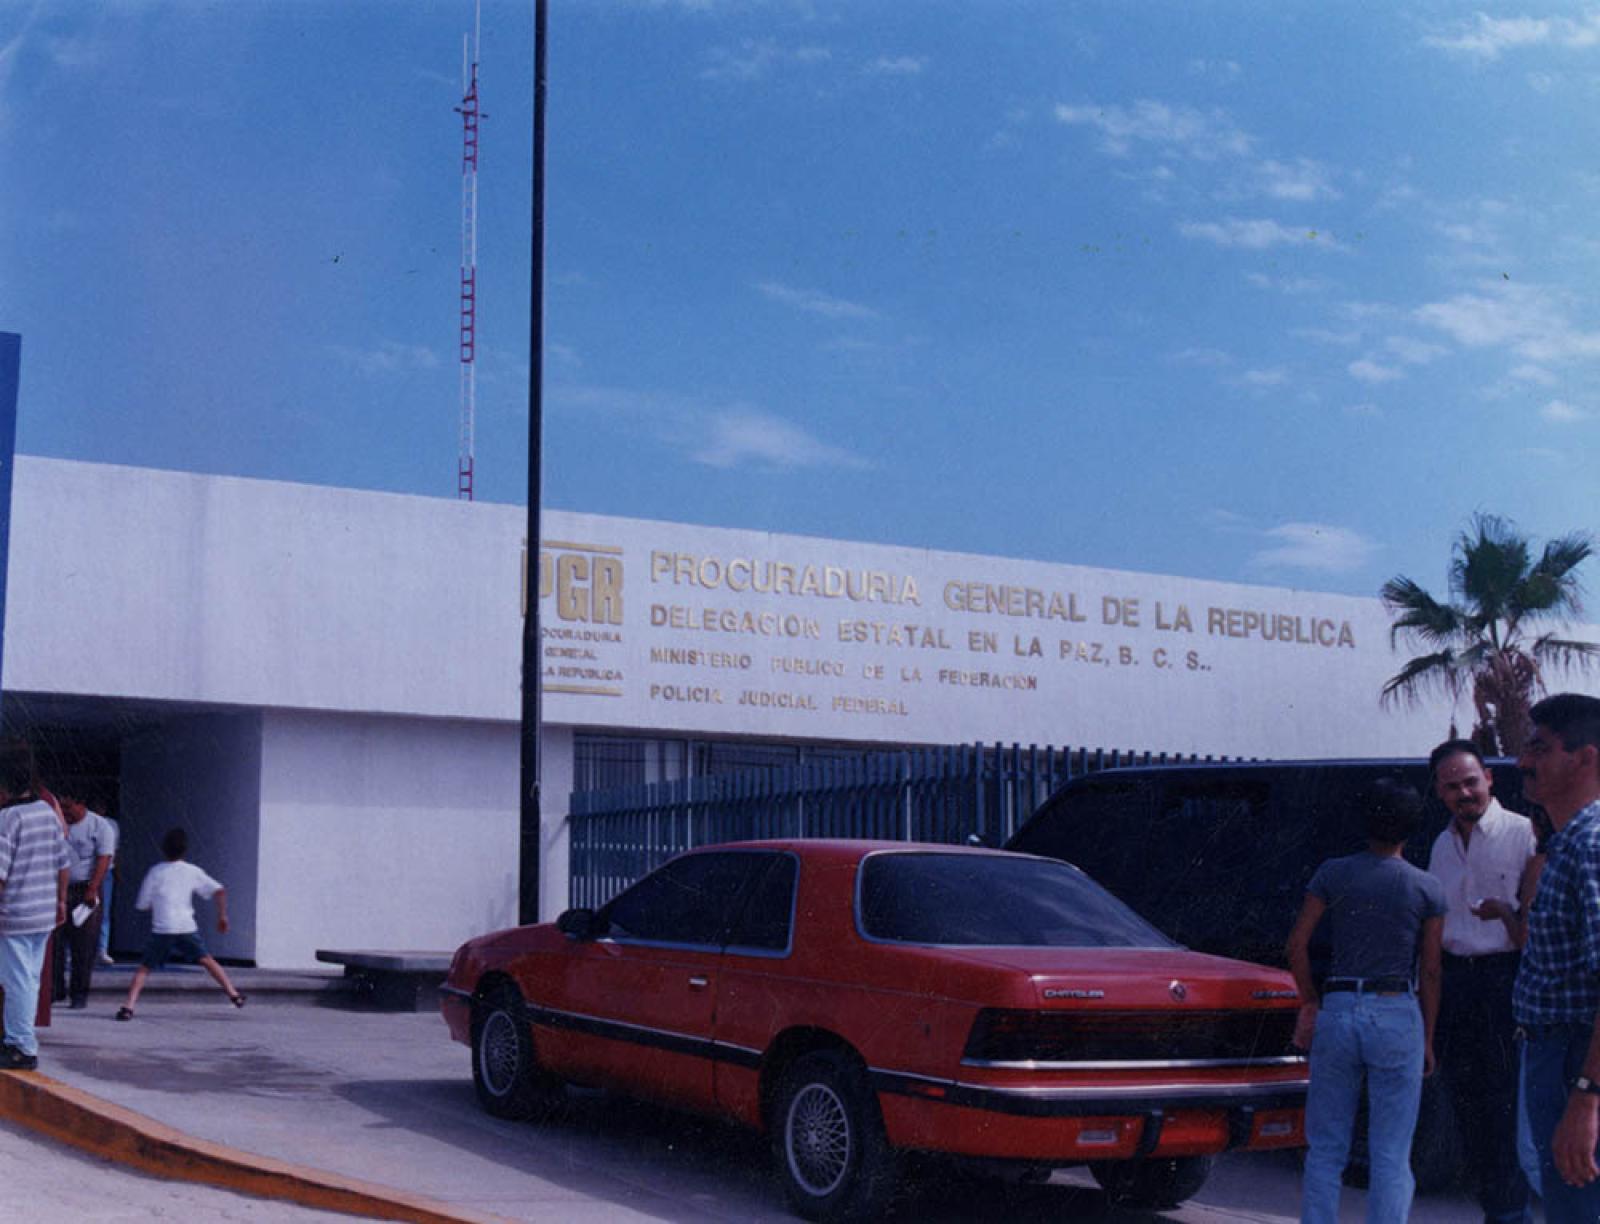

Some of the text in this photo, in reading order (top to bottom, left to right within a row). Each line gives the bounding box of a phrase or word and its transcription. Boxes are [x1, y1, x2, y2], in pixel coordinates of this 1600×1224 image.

[651, 550, 1355, 648] PROCURADURIA GENERAL DE LA REPUBLICA
[651, 604, 821, 640] DELEGACION
[838, 620, 951, 649] ESTATAL
[968, 631, 998, 654] EN
[1014, 634, 1043, 657] LA
[1059, 639, 1110, 667] PAZ,
[1119, 645, 1139, 665] B.
[1153, 648, 1173, 668] C.
[651, 648, 1037, 690] MINISTERIO PUBLICO DE LA FEDERACION
[651, 685, 909, 716] POLICIA JUDICIAL FEDERAL
